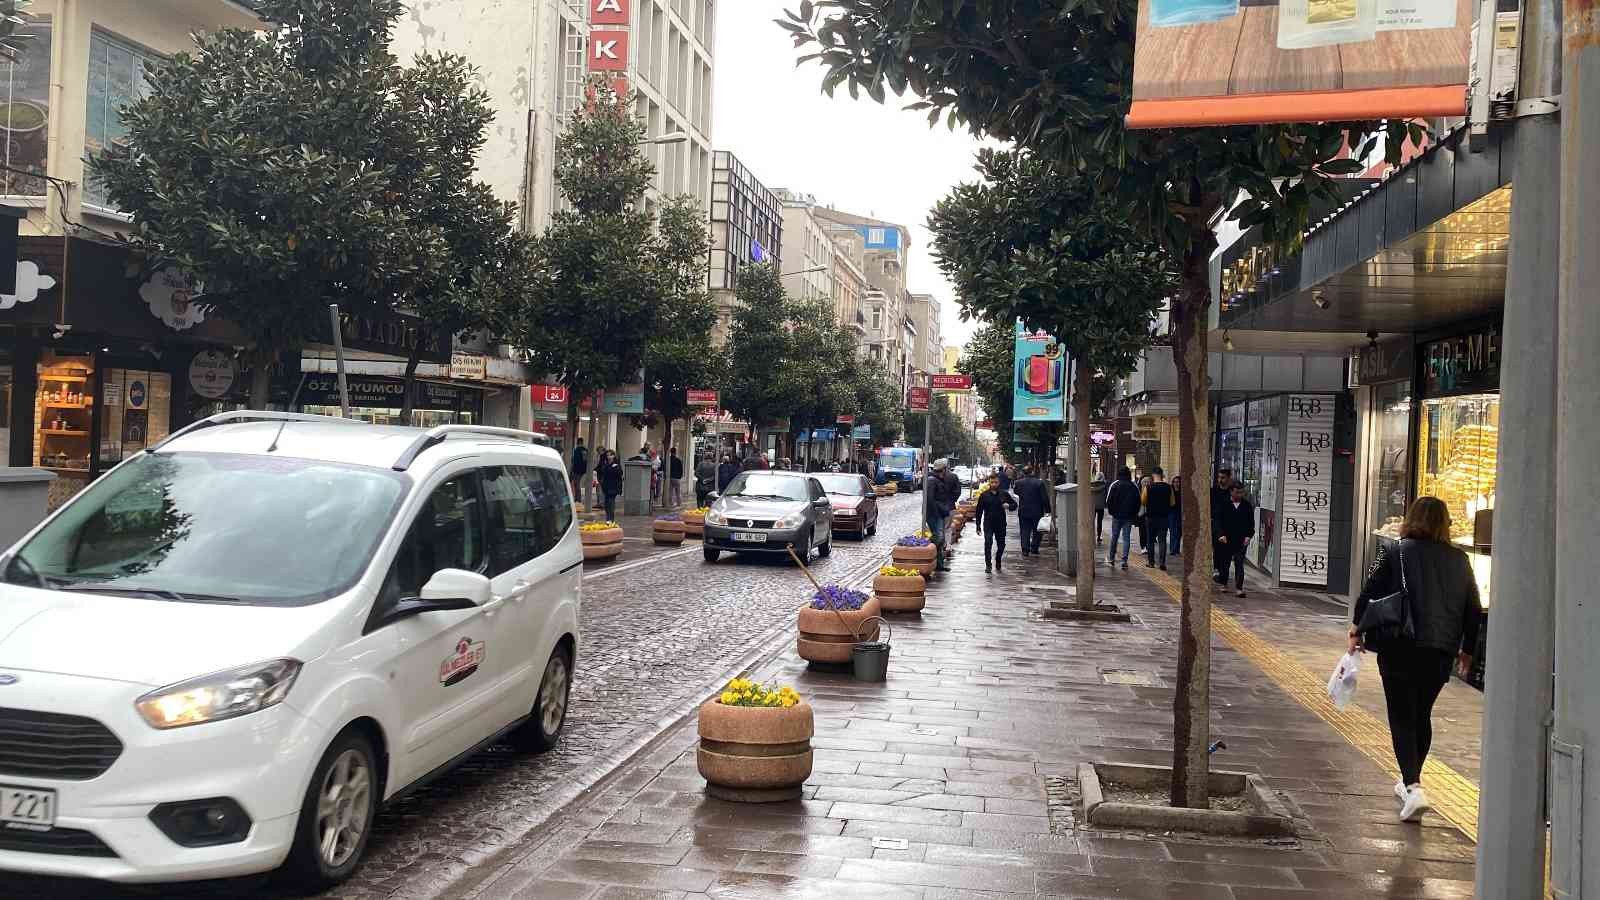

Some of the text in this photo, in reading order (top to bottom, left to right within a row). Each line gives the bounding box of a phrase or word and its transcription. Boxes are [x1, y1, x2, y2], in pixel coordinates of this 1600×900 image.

[308, 379, 329, 391] ÖZ
[1289, 397, 1321, 418] BRB
[1299, 431, 1330, 452] BRB
[1288, 460, 1319, 481] BRB
[1297, 488, 1328, 510] BRB
[1286, 517, 1316, 539] BRB
[1295, 552, 1325, 574] BRB
[10, 793, 50, 820] 221
